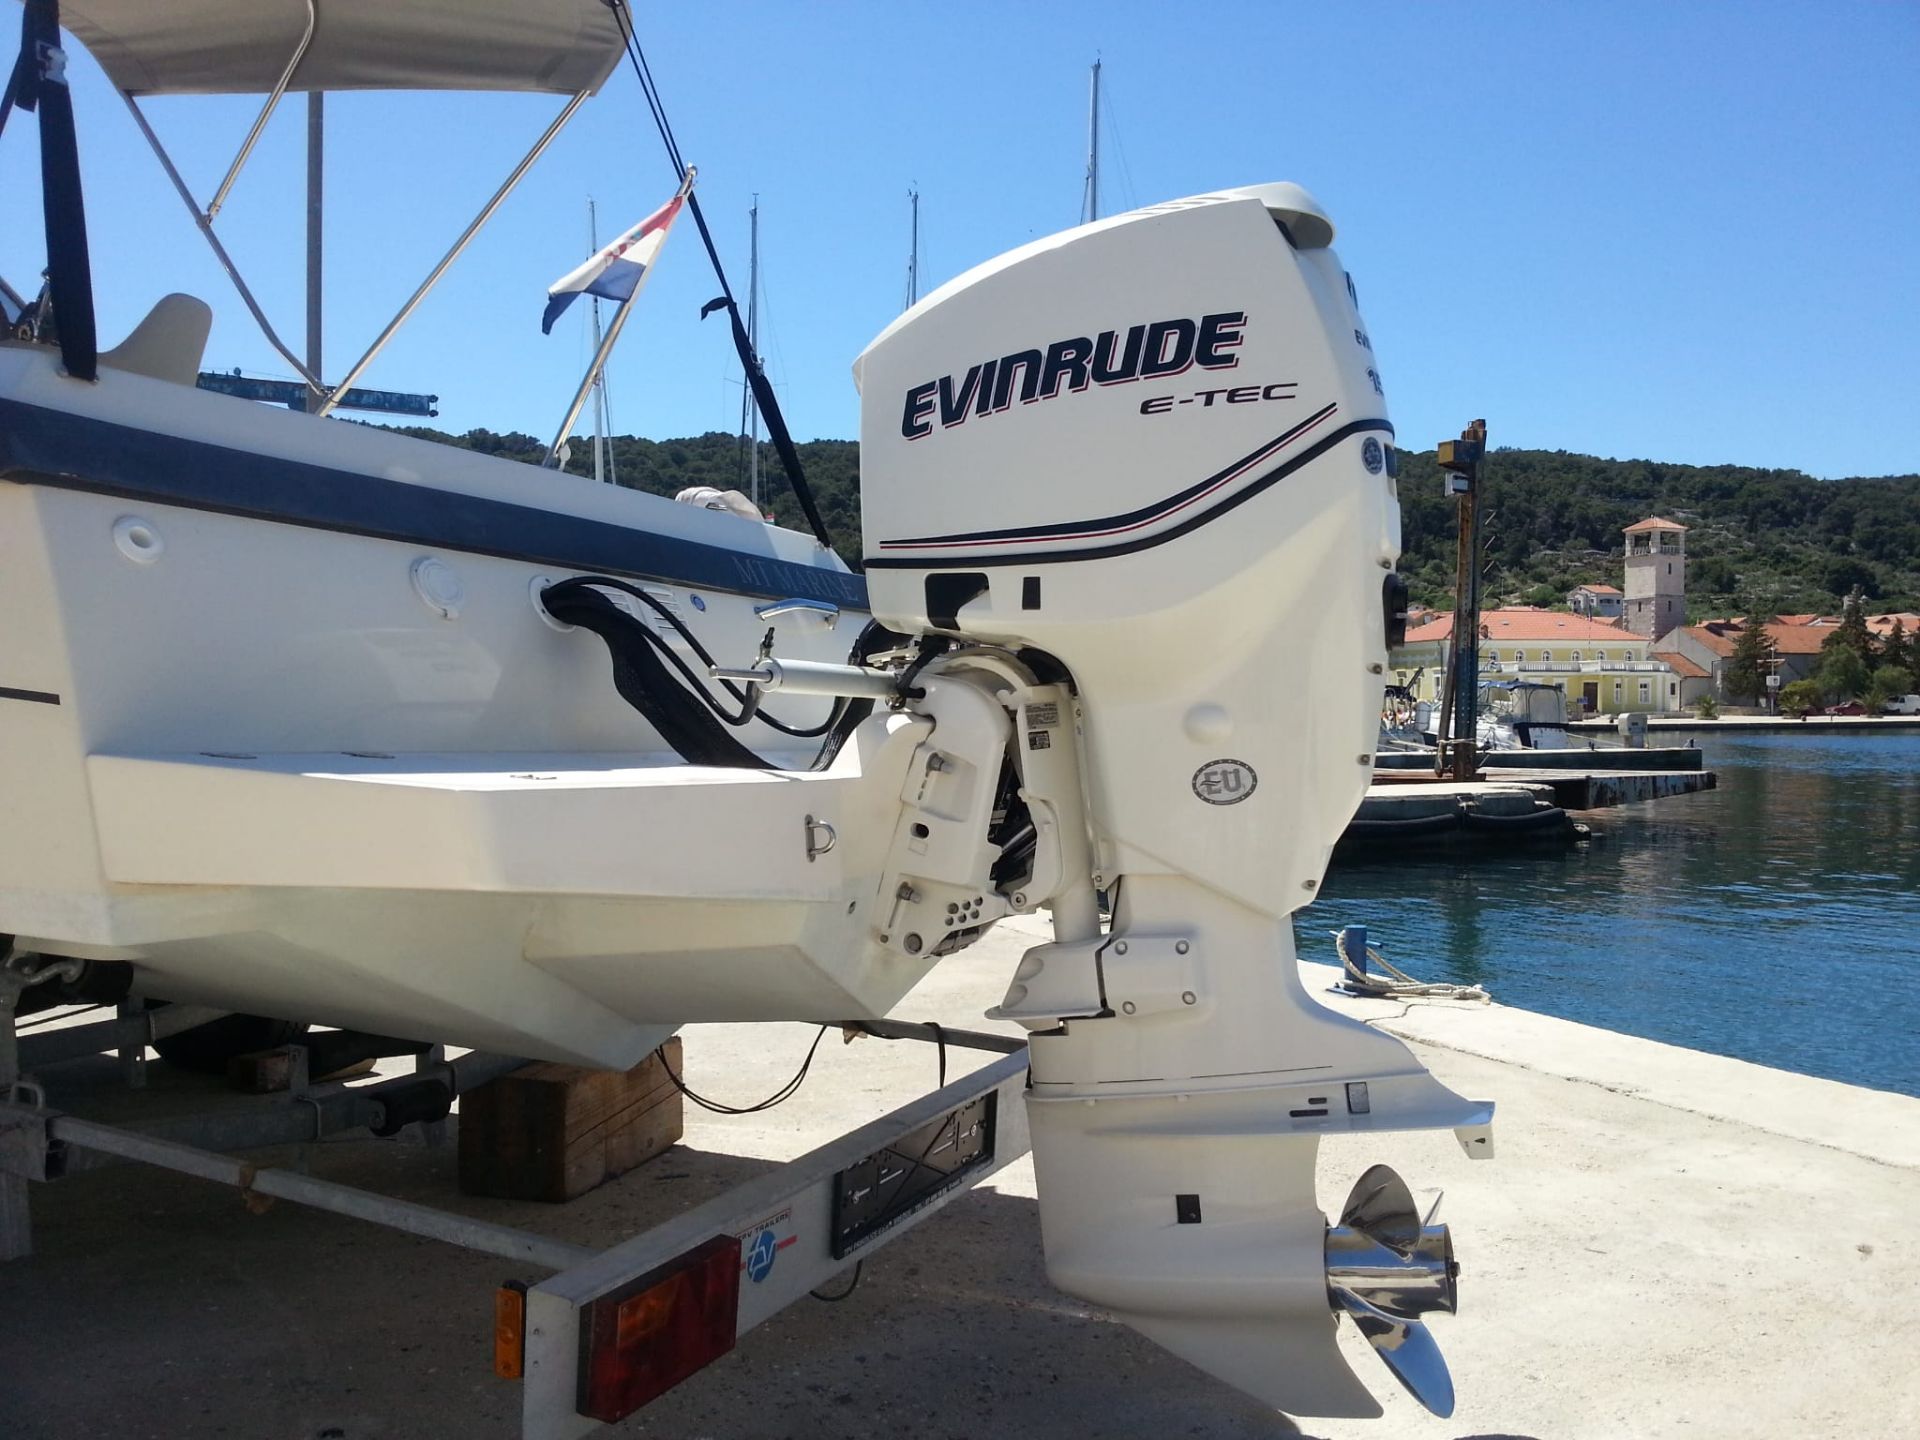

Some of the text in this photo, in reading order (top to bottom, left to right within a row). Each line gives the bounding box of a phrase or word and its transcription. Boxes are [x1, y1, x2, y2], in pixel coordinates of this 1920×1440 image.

[901, 311, 1248, 440] EVINRUDE
[1139, 382, 1299, 415] E-TEC
[730, 556, 861, 601] MT MARINE
